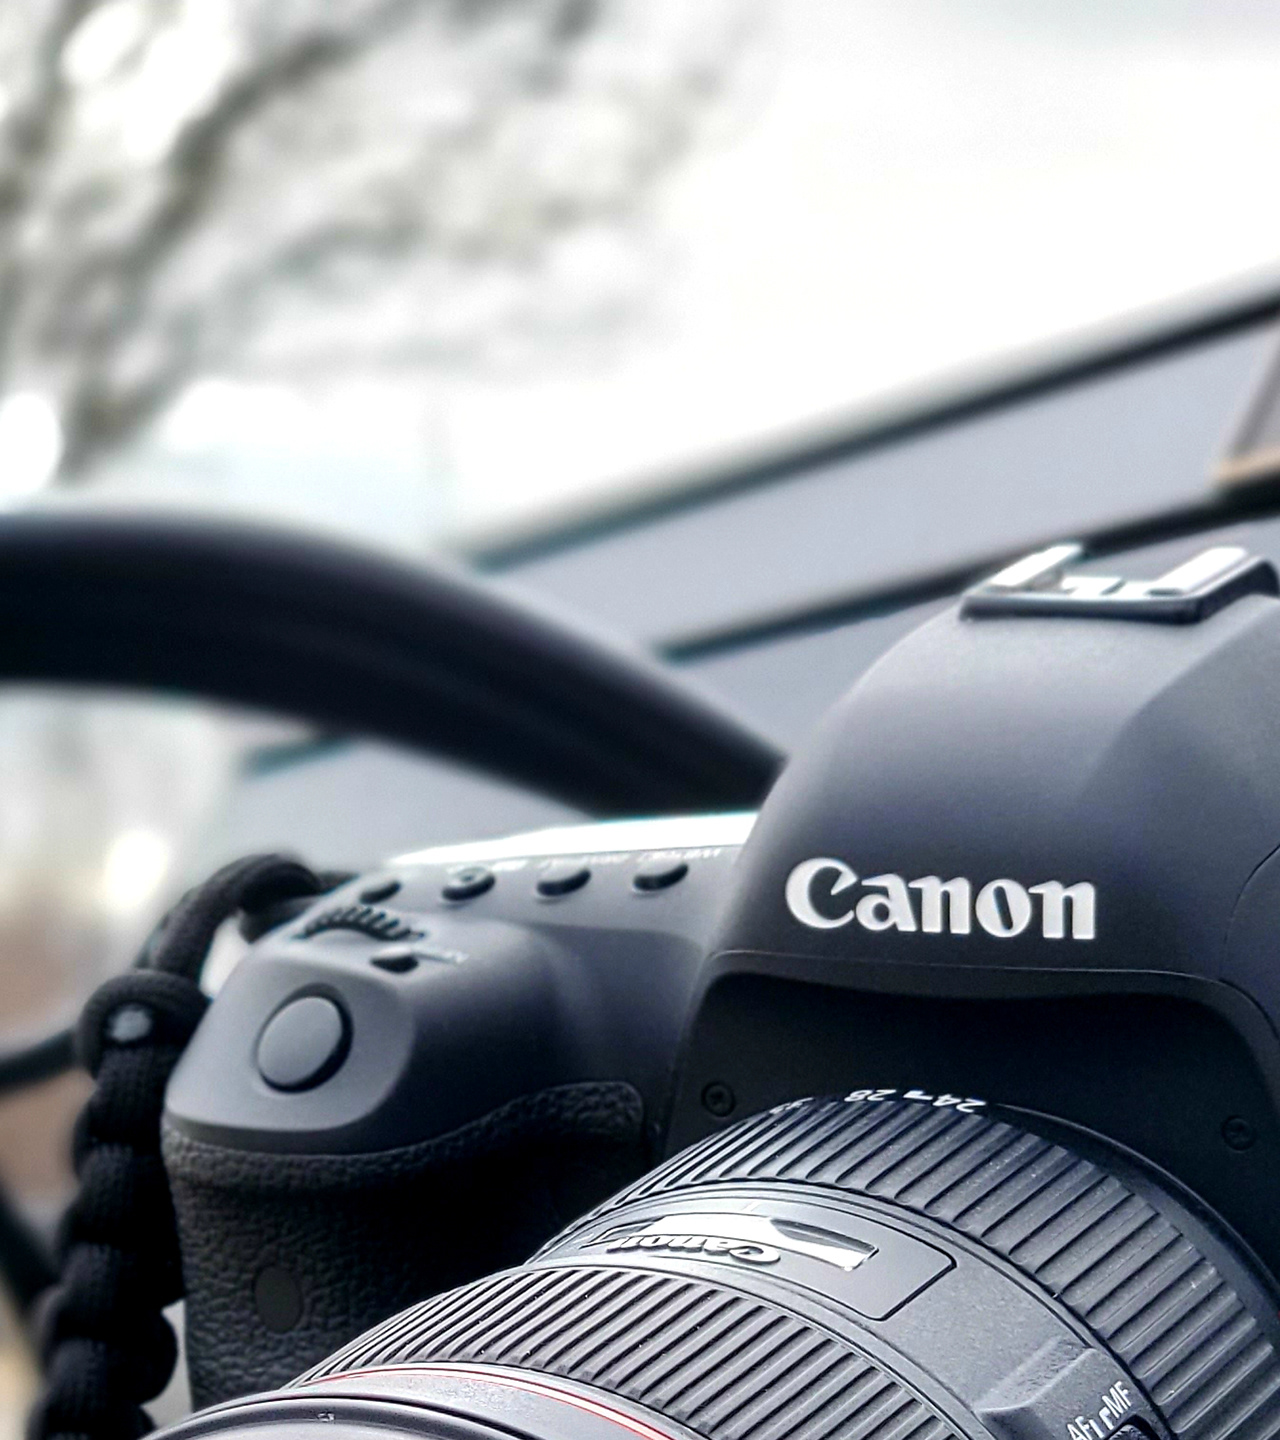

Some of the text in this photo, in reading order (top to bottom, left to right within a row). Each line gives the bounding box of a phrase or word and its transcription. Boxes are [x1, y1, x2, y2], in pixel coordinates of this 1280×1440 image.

[785, 857, 1095, 940] Canon
[932, 1093, 986, 1113] 24
[606, 1235, 781, 1265] Canon
[1101, 1380, 1132, 1418] MF
